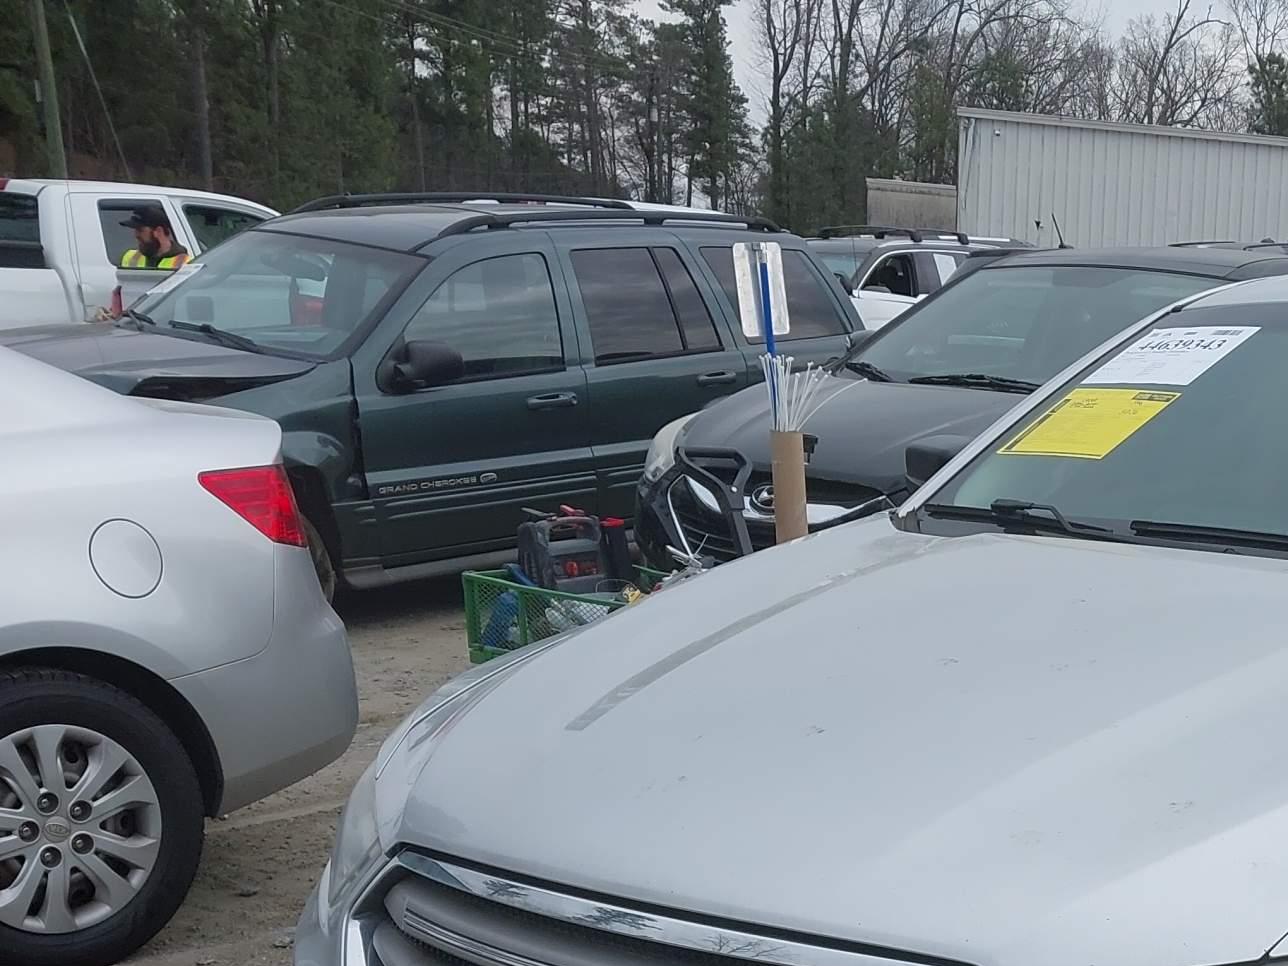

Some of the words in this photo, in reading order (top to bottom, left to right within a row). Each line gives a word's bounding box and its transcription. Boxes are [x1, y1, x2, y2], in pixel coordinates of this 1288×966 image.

[1138, 339, 1228, 351] 44639343
[378, 483, 418, 495] GRAND
[420, 476, 477, 489] CHEROKEE
